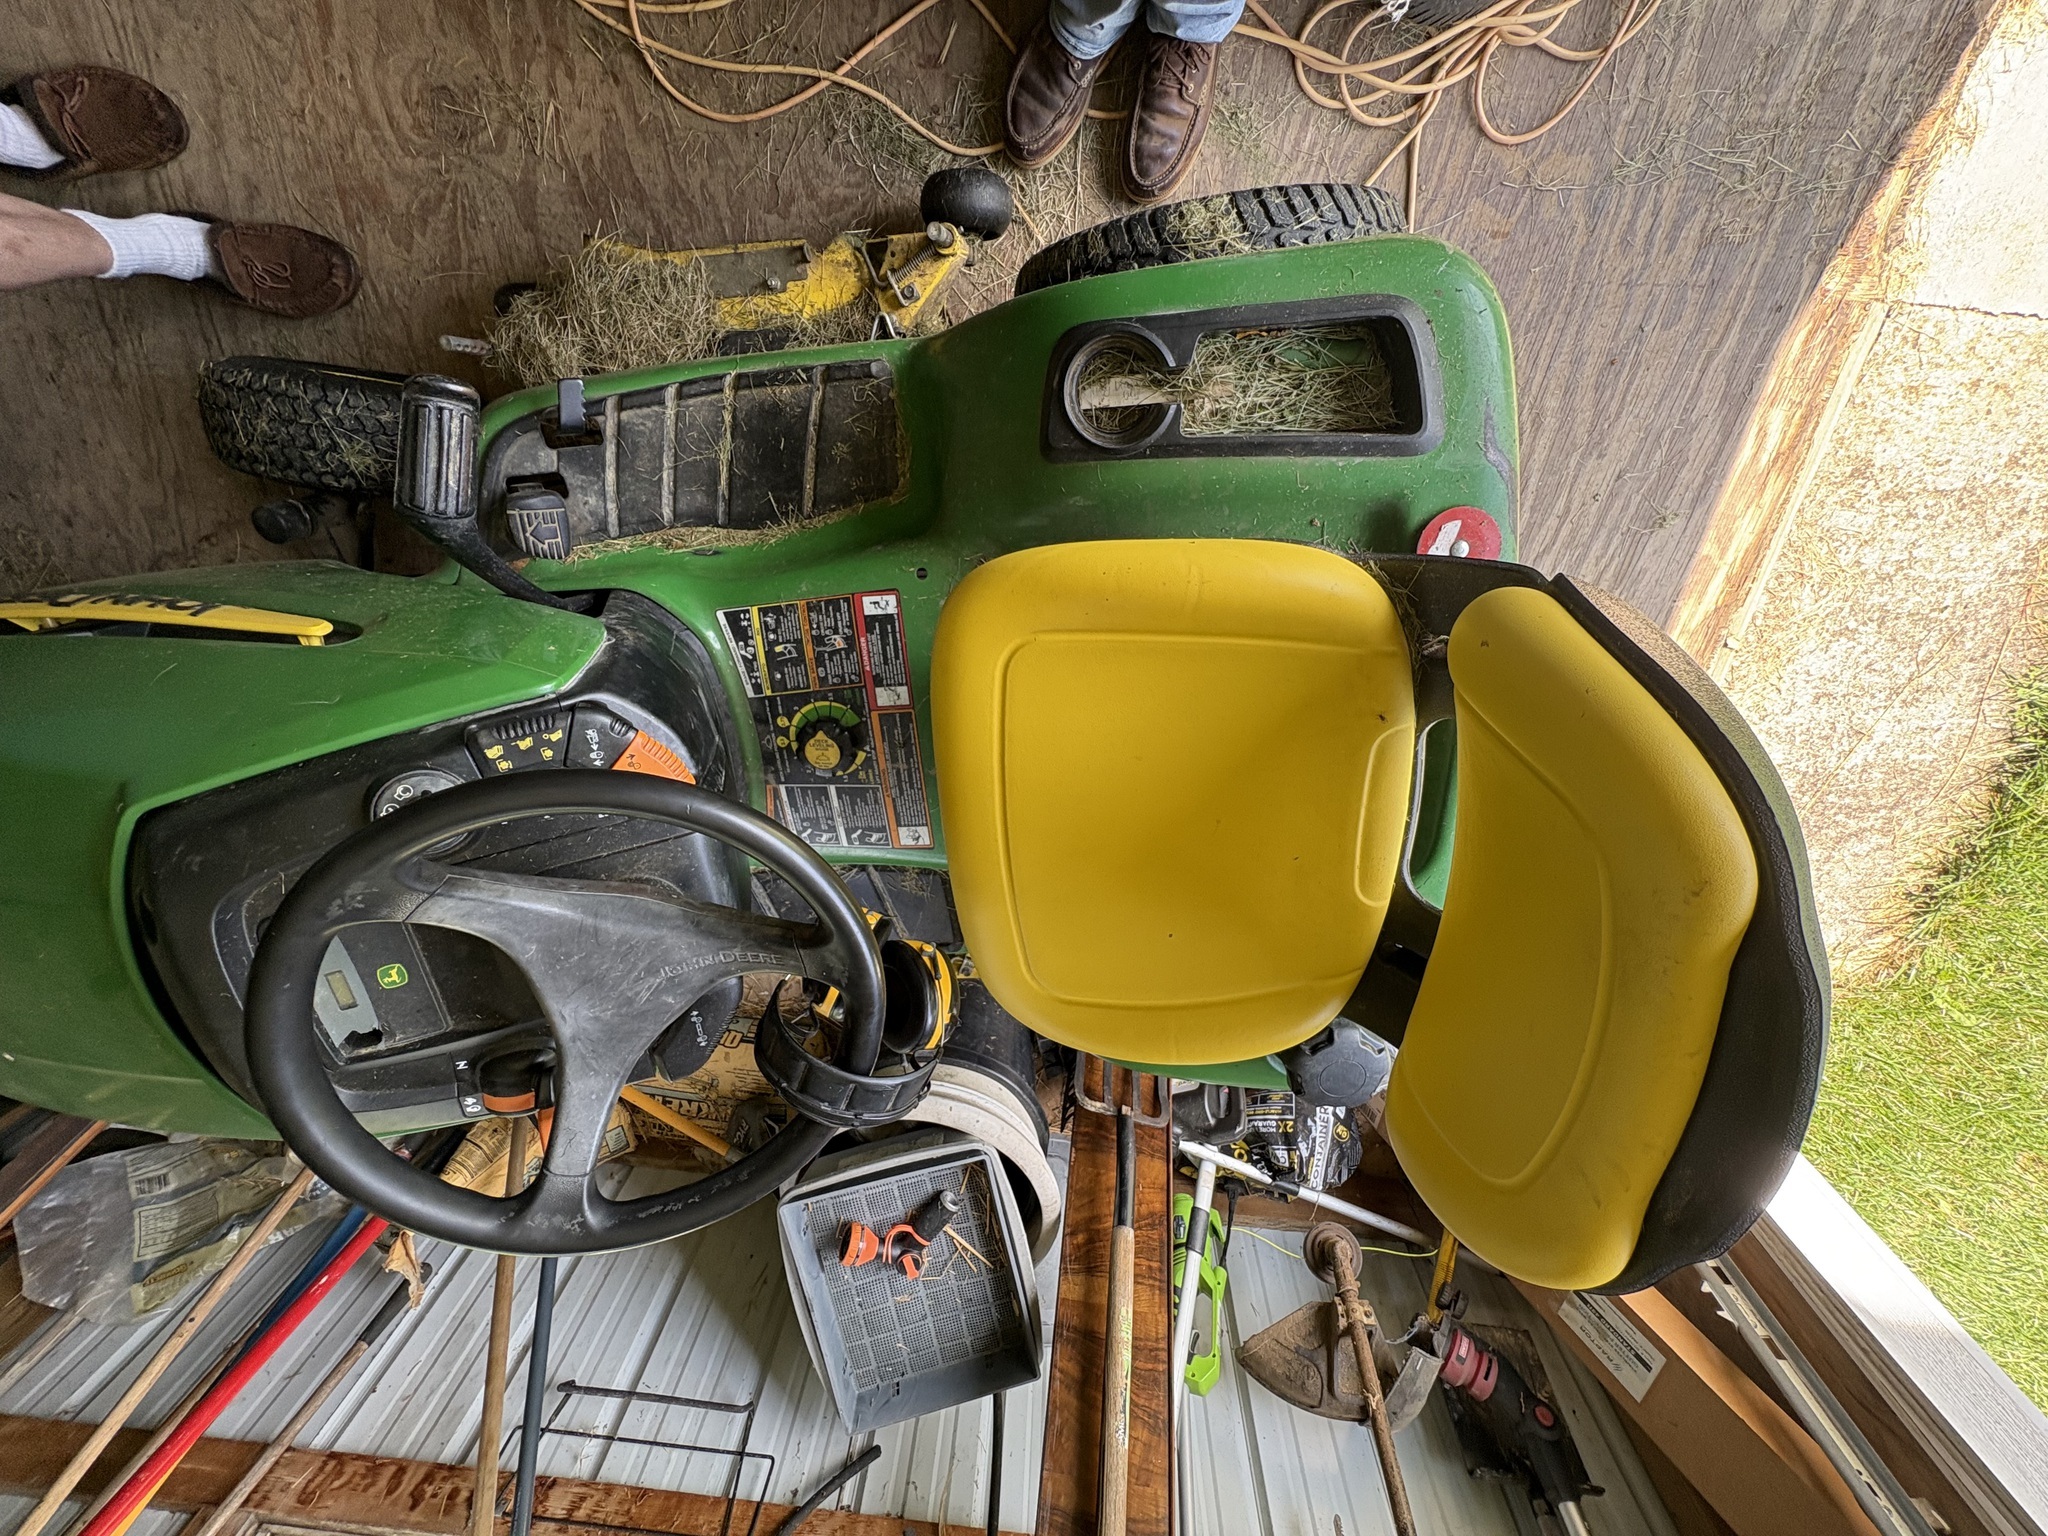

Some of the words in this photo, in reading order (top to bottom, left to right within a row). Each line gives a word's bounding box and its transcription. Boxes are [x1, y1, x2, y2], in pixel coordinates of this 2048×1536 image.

[860, 636, 869, 664] DANGER
[660, 954, 717, 979] JOHN
[719, 951, 784, 965] DEERE
[1277, 1120, 1294, 1133] 2X
[1577, 1303, 1615, 1342] PROTECTION
[1599, 1316, 1636, 1355] STANDARD
[1579, 1324, 1614, 1363] RAPTOR
[1613, 1341, 1639, 1369] GUTTER
